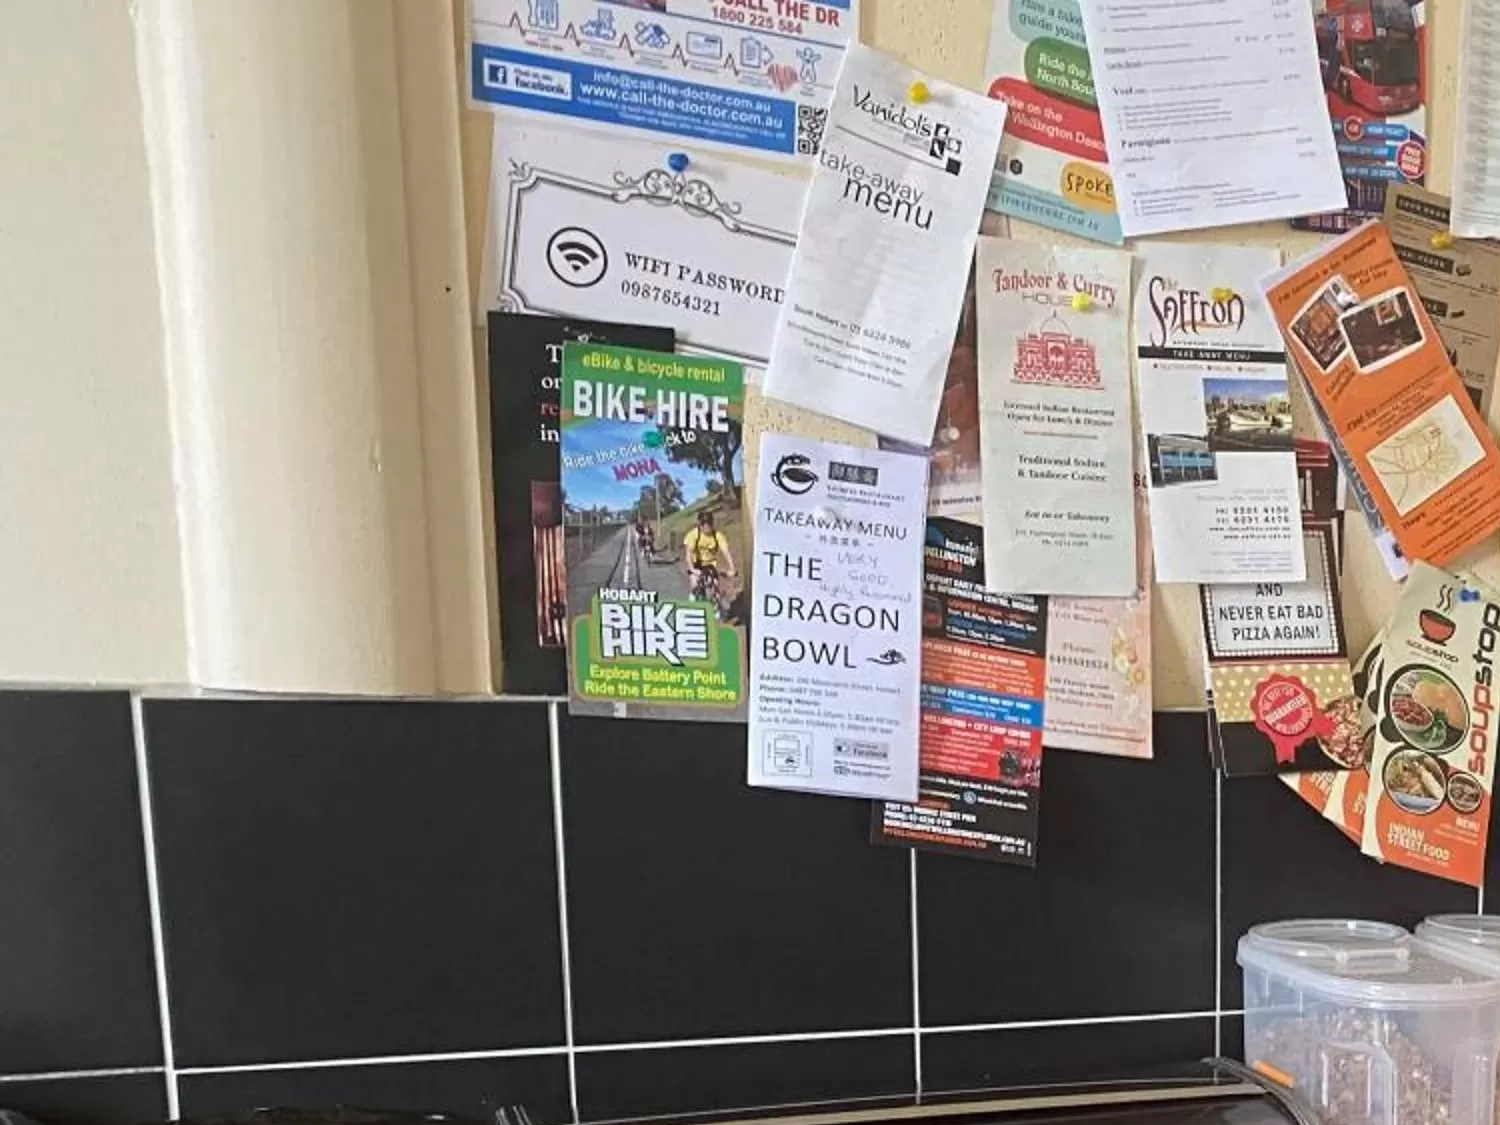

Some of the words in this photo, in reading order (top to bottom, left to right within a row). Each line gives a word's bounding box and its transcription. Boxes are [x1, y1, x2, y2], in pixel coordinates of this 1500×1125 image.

[711, 6, 745, 24] 1800
[773, 0, 808, 20] THE
[816, 8, 840, 27] DR
[1039, 52, 1066, 72] Ride
[1037, 67, 1070, 89] North
[580, 83, 784, 130] www.call-the-doctor.com.au
[593, 71, 772, 114] info@call-the-doctor.com.au
[1027, 101, 1041, 115] on
[1044, 105, 1064, 122] the
[820, 148, 925, 206] take-away
[843, 178, 933, 230] menu
[624, 252, 671, 278] WIFI
[620, 279, 722, 316] 0987654321
[992, 268, 1054, 293] Tandoor
[1056, 271, 1069, 291] &
[1072, 272, 1117, 309] Curry
[582, 351, 621, 371] eBike
[623, 354, 635, 373] &
[637, 358, 683, 379] bicycle
[687, 367, 725, 383] rental
[572, 379, 649, 424] BIKE
[656, 388, 729, 434] HIRE
[612, 457, 662, 482] MONA
[764, 507, 853, 532] TAKEAWAY
[859, 520, 907, 541] MENU
[762, 551, 823, 581] THE
[599, 587, 658, 603] HOBART
[1255, 582, 1284, 597] AND
[600, 602, 708, 634] BIKE
[762, 593, 900, 633] DRAGON
[1219, 604, 1263, 621] NEVER
[1267, 604, 1293, 620] EAT
[1296, 604, 1324, 620] BAD
[601, 626, 709, 667] HIRE
[1231, 626, 1271, 641] PIZZA
[1273, 624, 1321, 641] AGAIN!
[763, 636, 857, 669] BOWL
[589, 663, 640, 681] Explore
[641, 667, 690, 686] Battery
[693, 670, 727, 686] Point
[583, 679, 615, 695] Ride
[618, 682, 640, 698] the
[642, 683, 695, 699] Eastern
[697, 685, 737, 701] Shore
[1388, 822, 1425, 841] INDIAN
